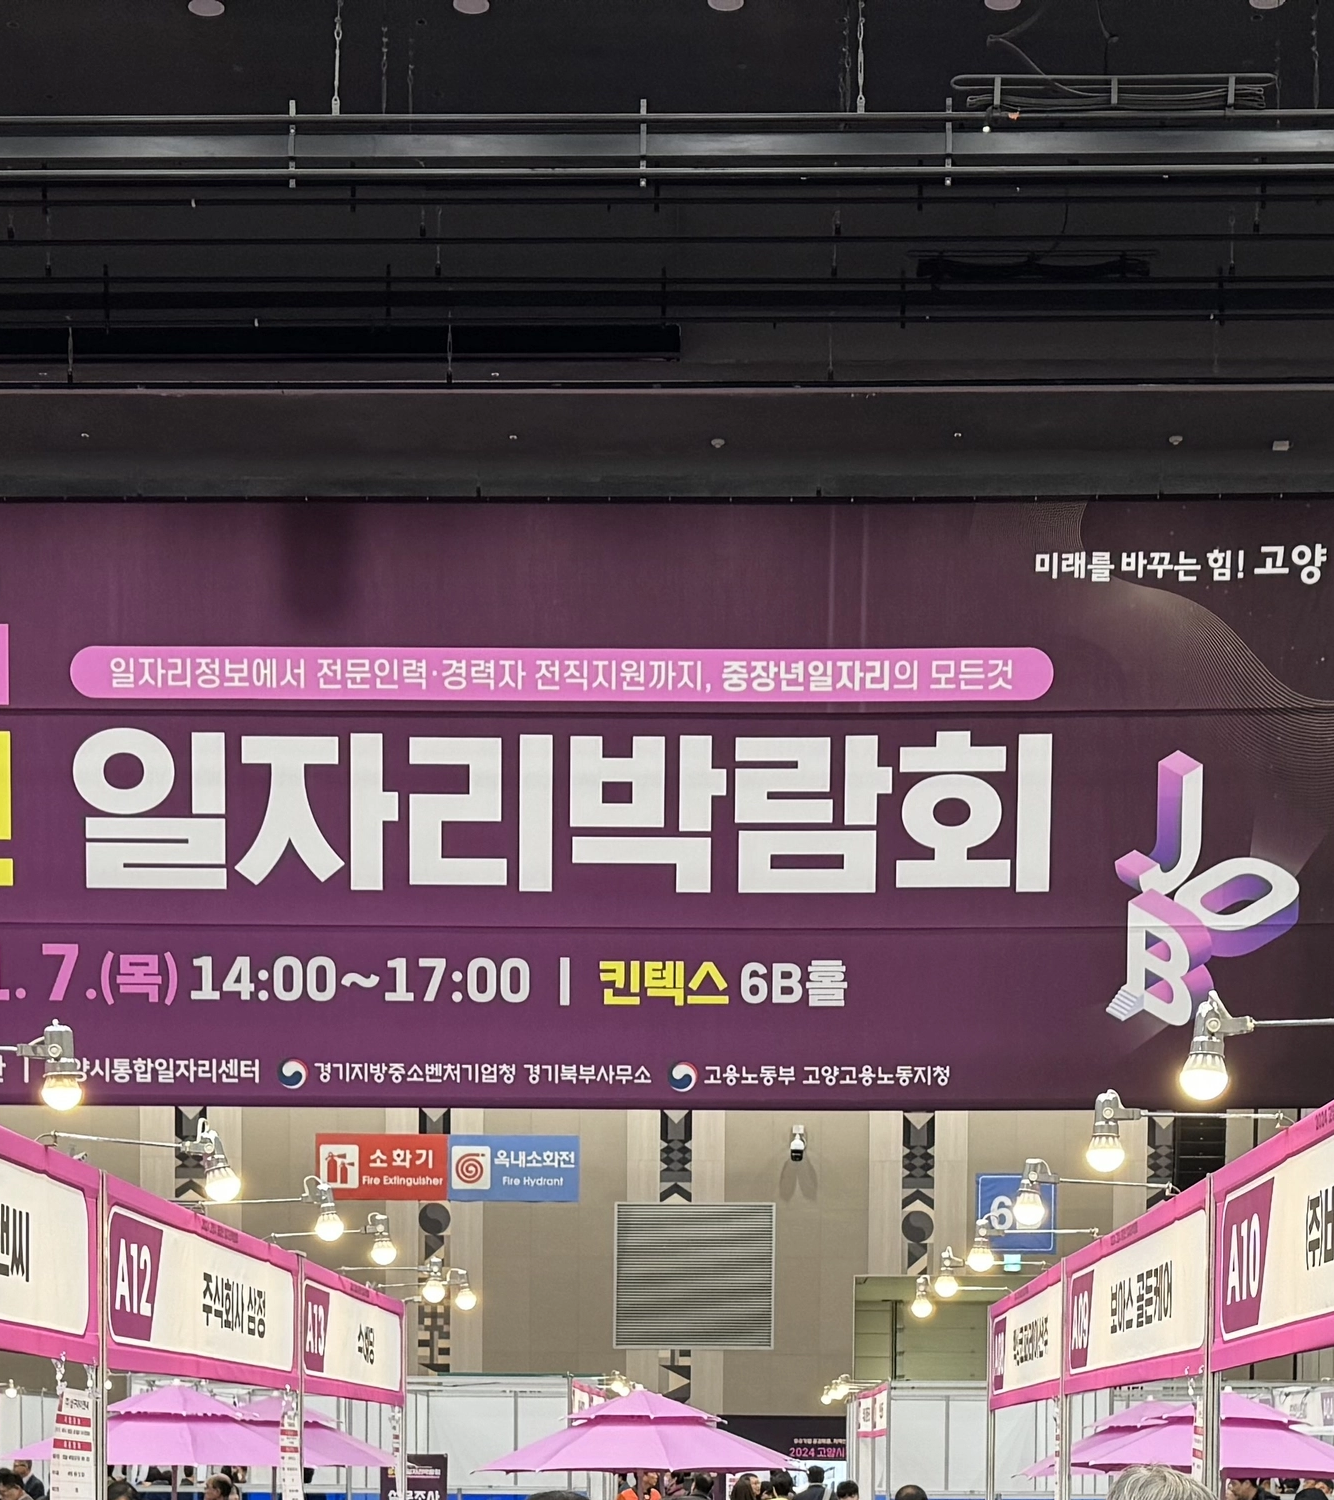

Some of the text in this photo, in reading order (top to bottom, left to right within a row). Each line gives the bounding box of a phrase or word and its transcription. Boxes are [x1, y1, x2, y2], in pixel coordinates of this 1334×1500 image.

[1036, 544, 1327, 584] 미래를 바꾸는 힘! 고양
[111, 658, 1012, 692] 일자리정보에서 전문인력·경력자 전직지원까지, 중장년일자리의 모든것
[73, 728, 1052, 893] 일자리박람회
[1106, 750, 1300, 1026] JOB
[42, 944, 177, 1005] 7.(목)
[191, 956, 529, 1002] 14:00~17:00
[600, 961, 729, 1006] 킨텍스
[741, 960, 847, 1006] 6B홀
[53, 1056, 260, 1085] 양시통합일자리센터
[314, 1061, 515, 1084] 경기지방중소벤처기업청
[524, 1062, 651, 1084] 경기북부사무소
[704, 1065, 795, 1086] 고용노동부
[803, 1065, 949, 1086] 고양고용노동지청
[362, 1175, 444, 1188] Fire Extinguisher
[370, 1149, 432, 1168] 소화기
[494, 1150, 574, 1167] 옥내소화전
[502, 1176, 564, 1188] Fire Hydrant
[115, 1238, 152, 1317] A12
[1226, 1211, 1261, 1306] A10
[202, 1271, 244, 1333] 주식회사
[1072, 1291, 1089, 1349] A09
[1110, 1277, 1134, 1335] 보아스
[1135, 1260, 1173, 1329] 골든케어
[305, 1301, 326, 1357] A13
[790, 1447, 815, 1458] 2024
